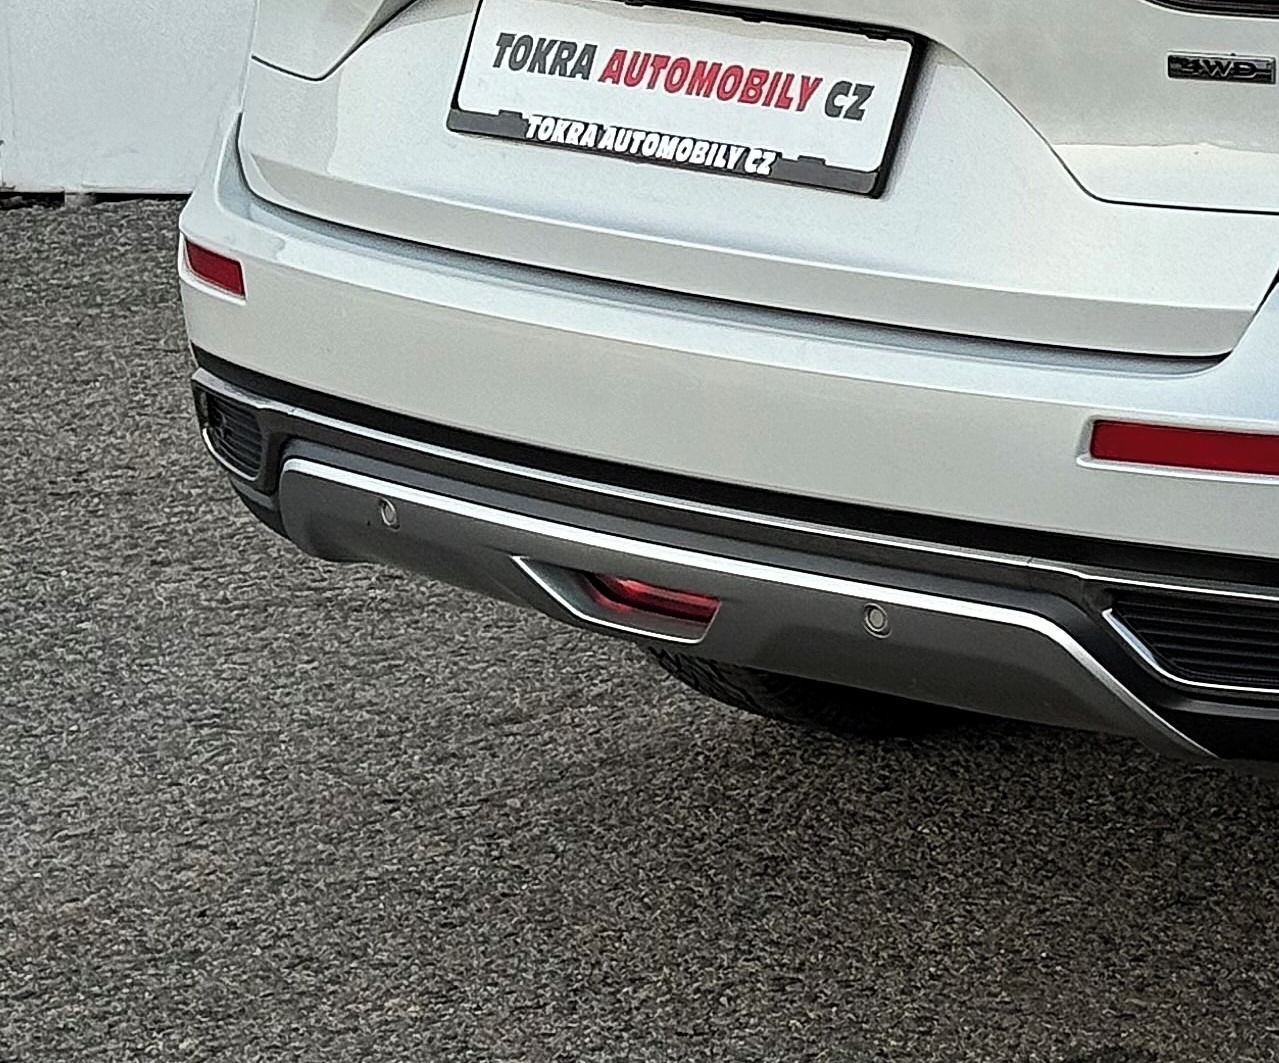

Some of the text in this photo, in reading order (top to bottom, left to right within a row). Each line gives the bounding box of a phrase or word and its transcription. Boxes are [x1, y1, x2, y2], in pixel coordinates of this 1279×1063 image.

[493, 32, 875, 120] TOKRA AUTOMOBILY CZ
[526, 116, 777, 176] TOKRA AUTOMOBILY CZ
